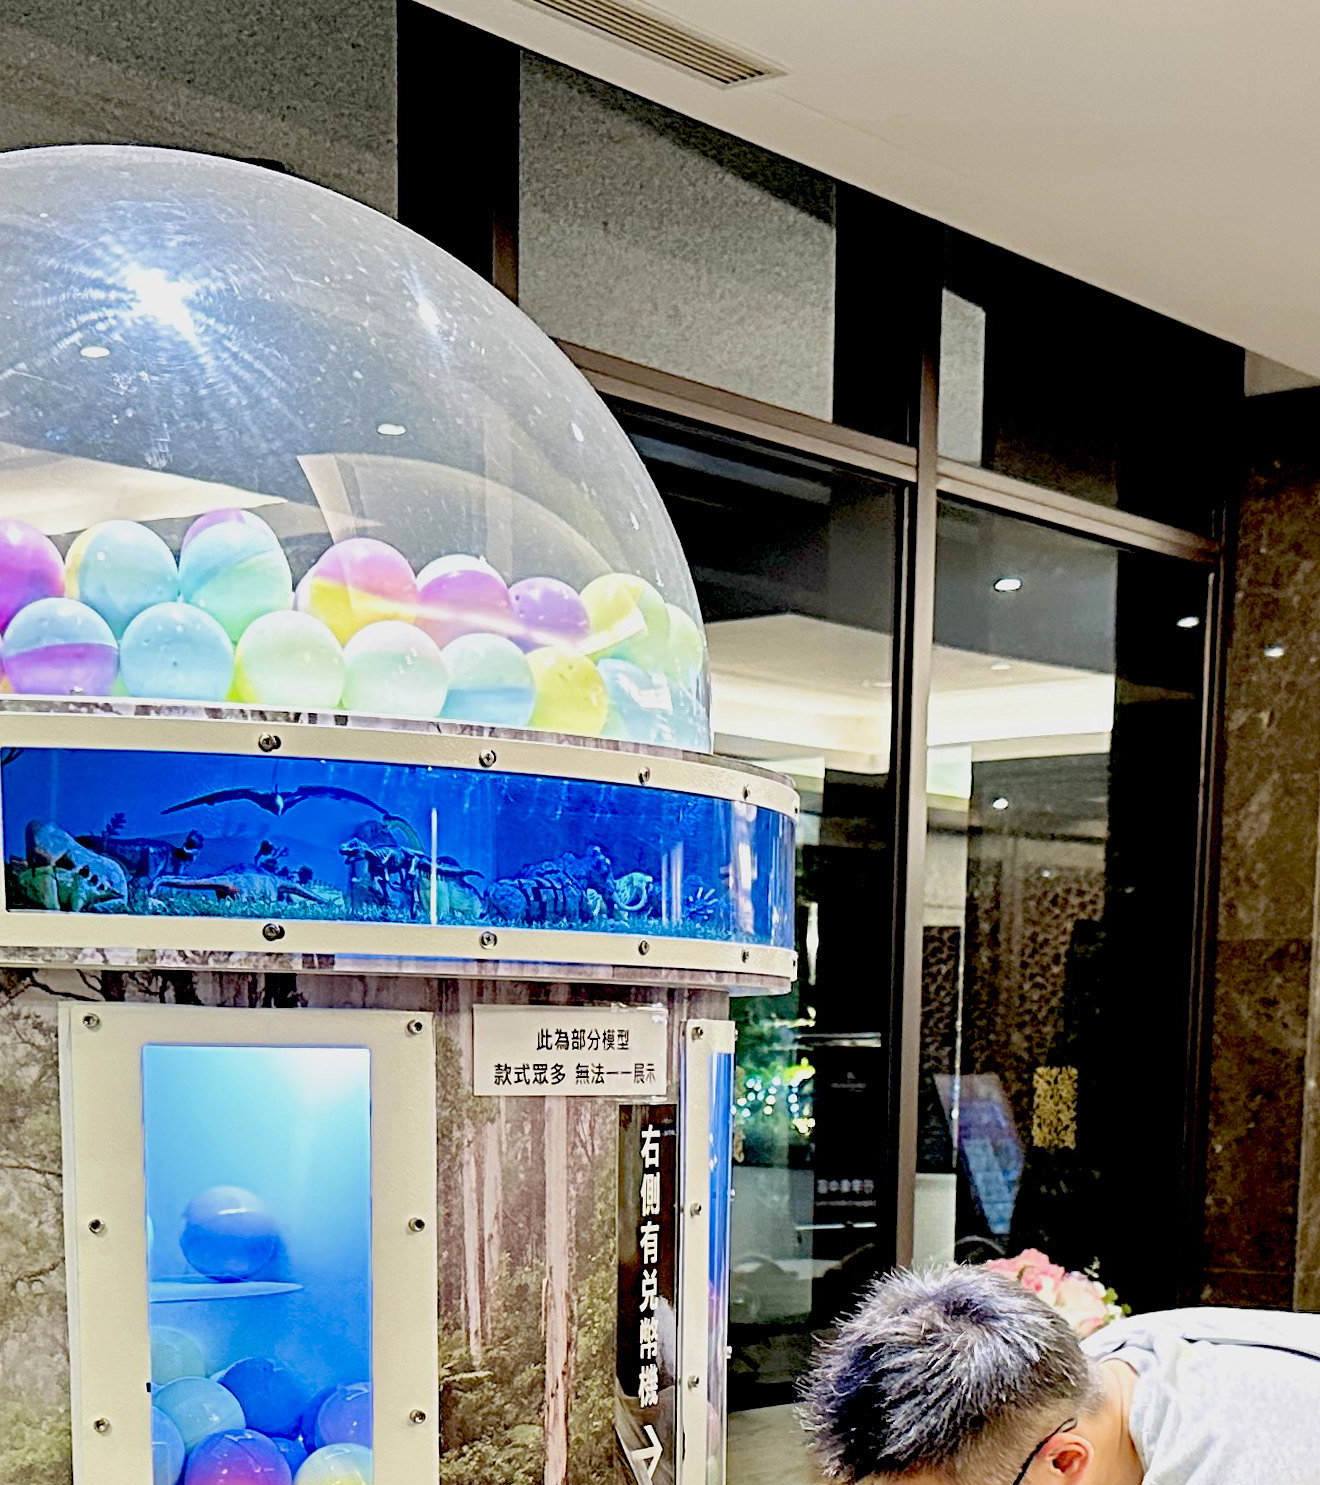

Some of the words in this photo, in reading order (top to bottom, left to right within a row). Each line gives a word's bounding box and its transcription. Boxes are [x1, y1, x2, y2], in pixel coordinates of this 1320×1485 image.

[536, 1028, 630, 1051] 此為部分模型
[494, 1063, 567, 1086] 款式眾多
[574, 1063, 657, 1085] 無法一一展示
